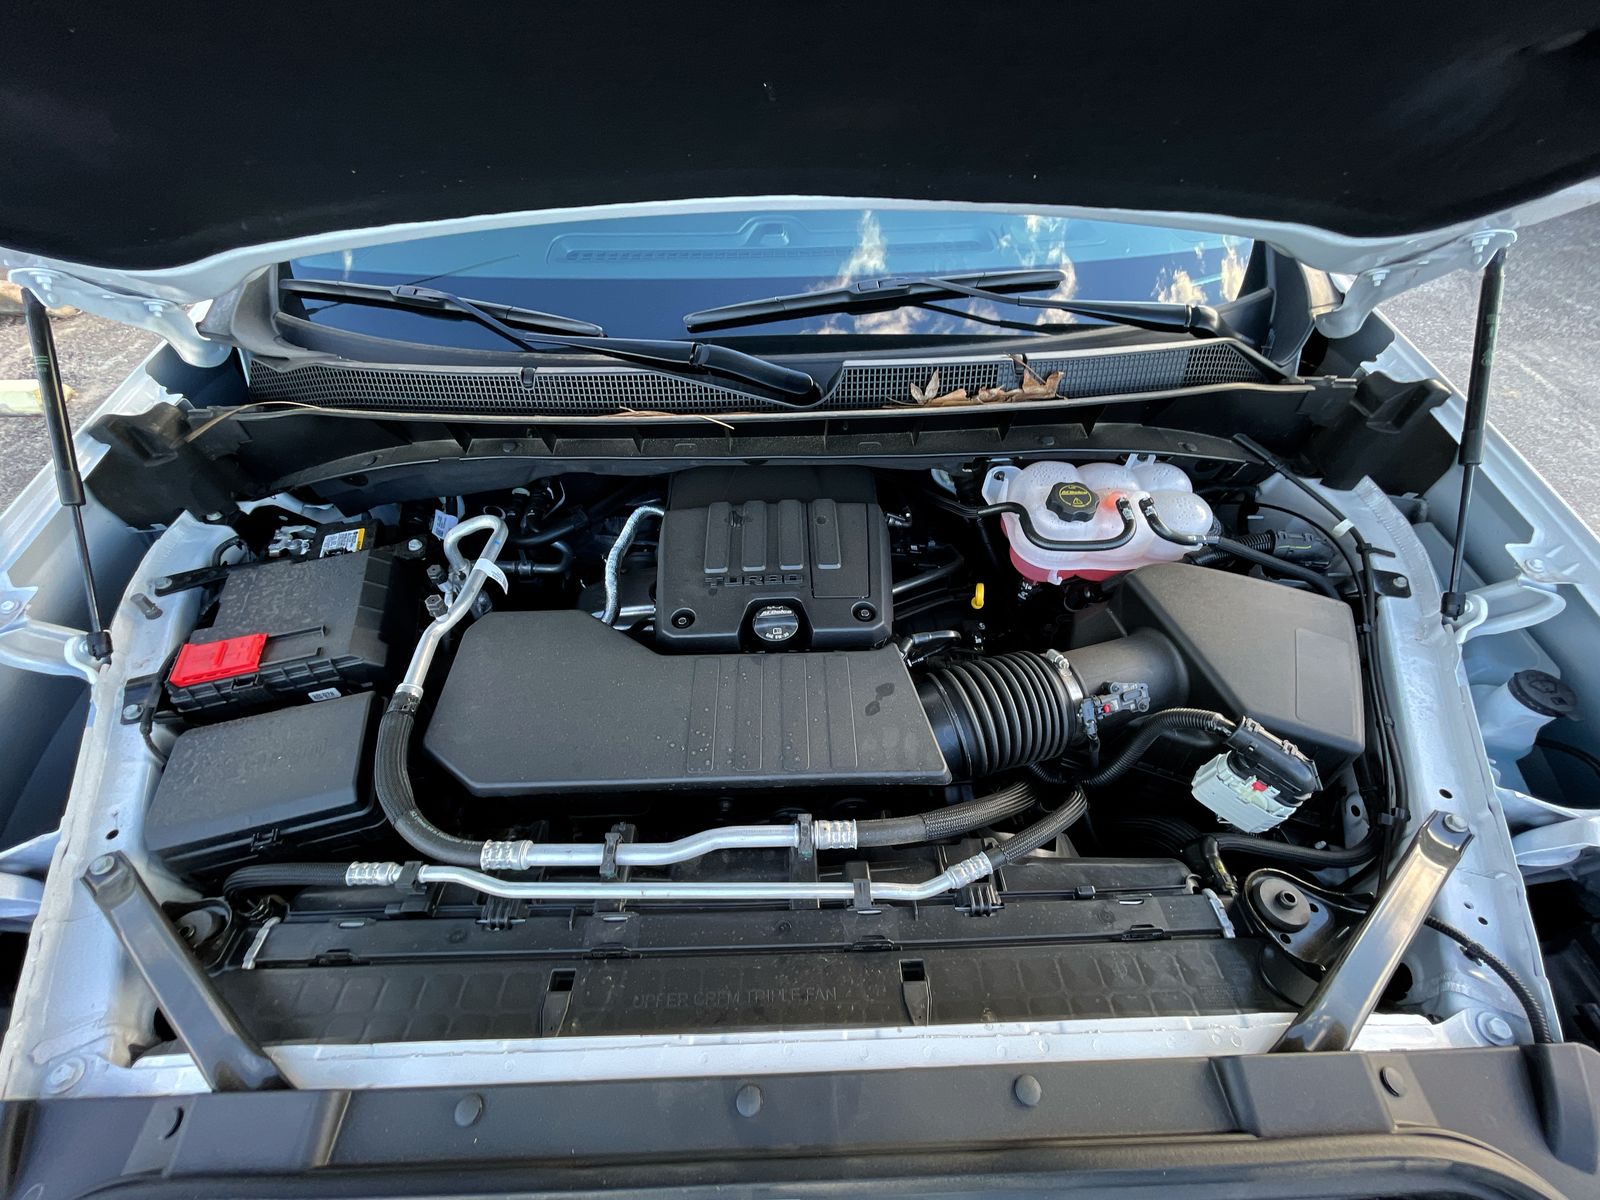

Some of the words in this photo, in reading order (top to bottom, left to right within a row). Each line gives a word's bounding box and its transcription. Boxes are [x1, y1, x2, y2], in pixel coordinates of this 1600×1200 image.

[705, 574, 803, 588] TURBO
[760, 609, 793, 617] ACDelco
[806, 986, 837, 1002] FAN
